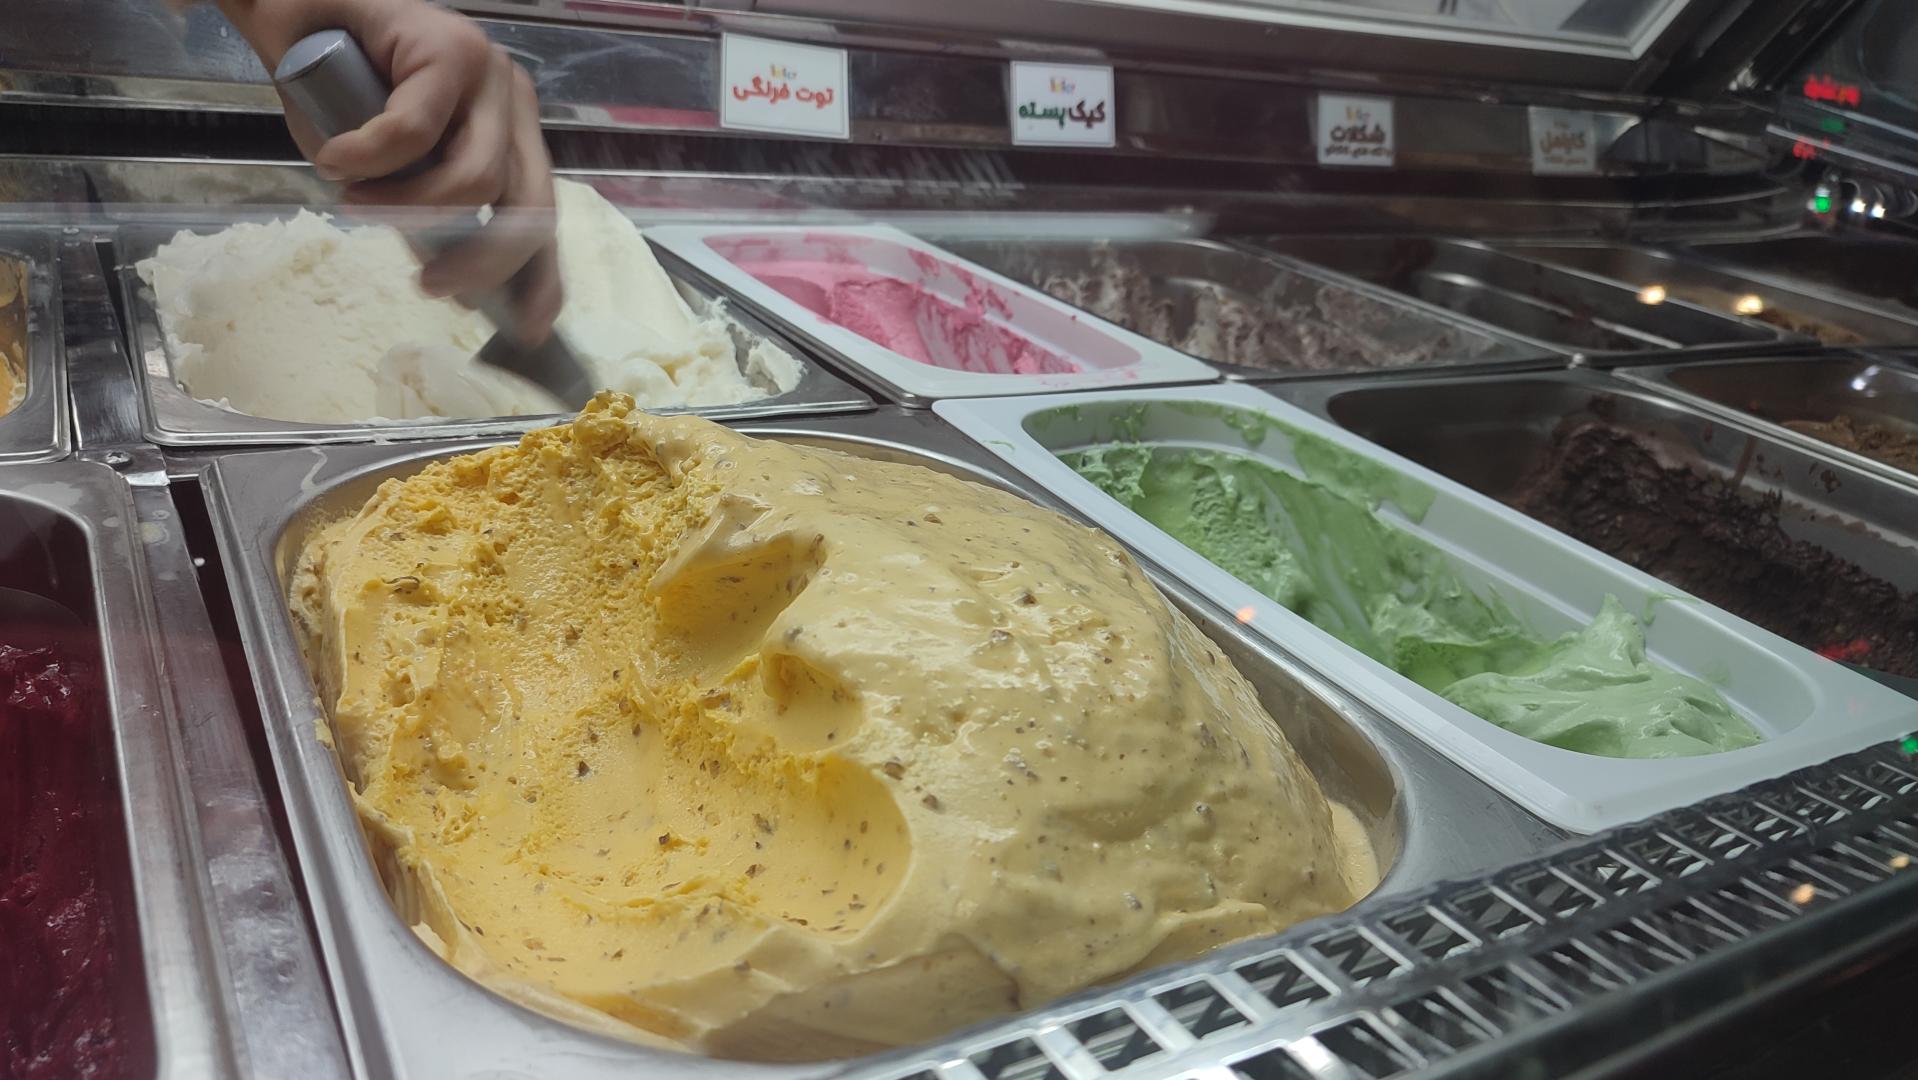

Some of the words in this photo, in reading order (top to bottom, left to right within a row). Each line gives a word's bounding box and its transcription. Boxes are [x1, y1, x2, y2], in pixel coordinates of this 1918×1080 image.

[732, 75, 790, 105] فرنگی
[795, 86, 833, 109] توت
[1018, 101, 1066, 130] پسته
[1068, 100, 1105, 129] کیک
